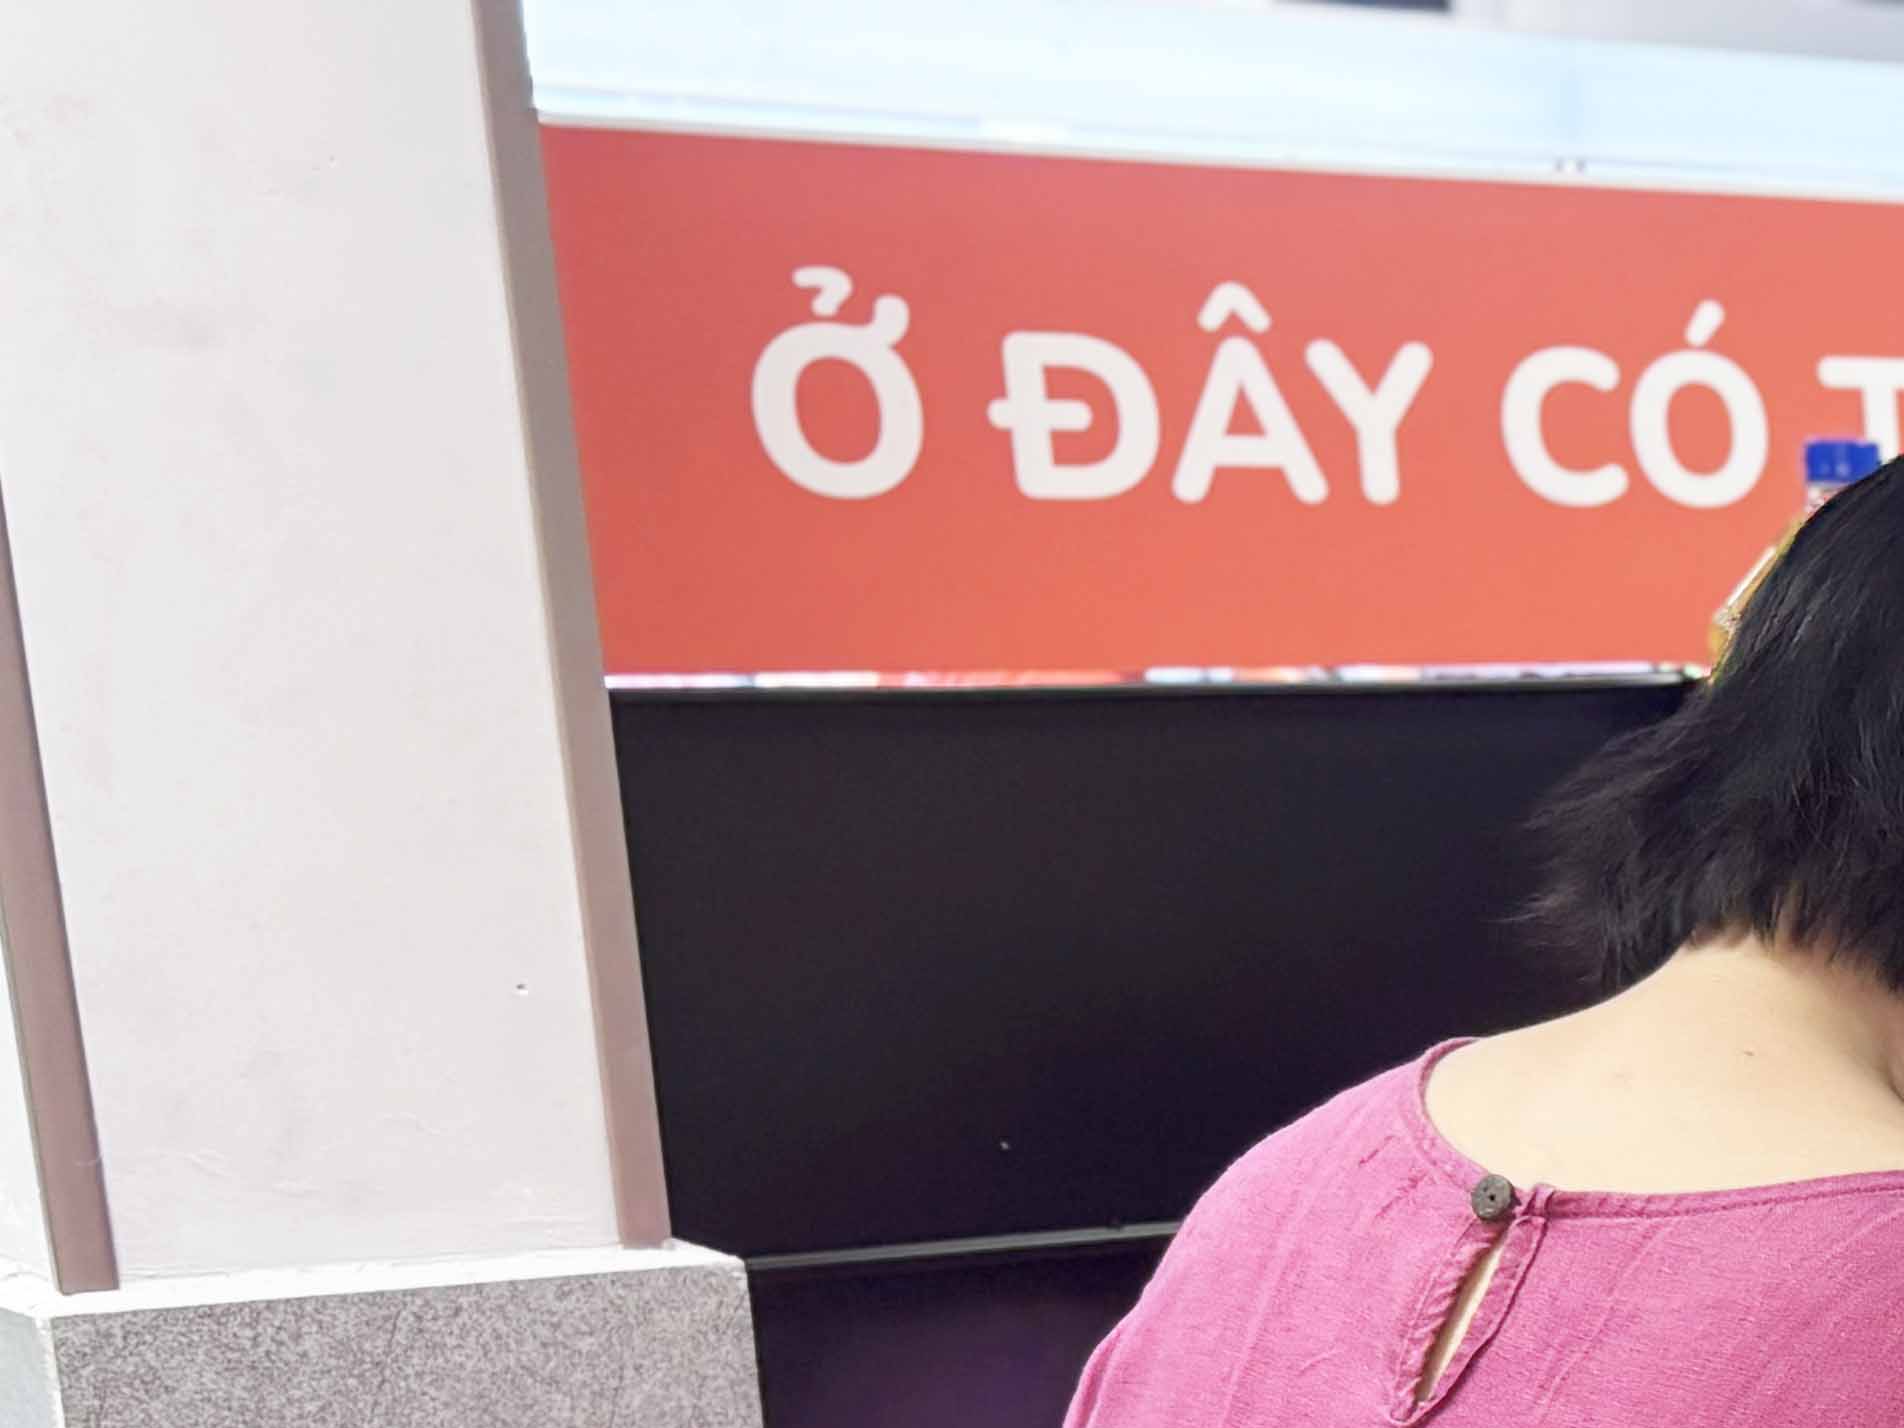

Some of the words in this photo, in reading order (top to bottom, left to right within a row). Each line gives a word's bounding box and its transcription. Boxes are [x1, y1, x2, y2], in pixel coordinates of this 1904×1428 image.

[752, 266, 922, 499] Ở
[988, 283, 1432, 504] ĐÂY
[1501, 300, 1770, 508] CÓ
